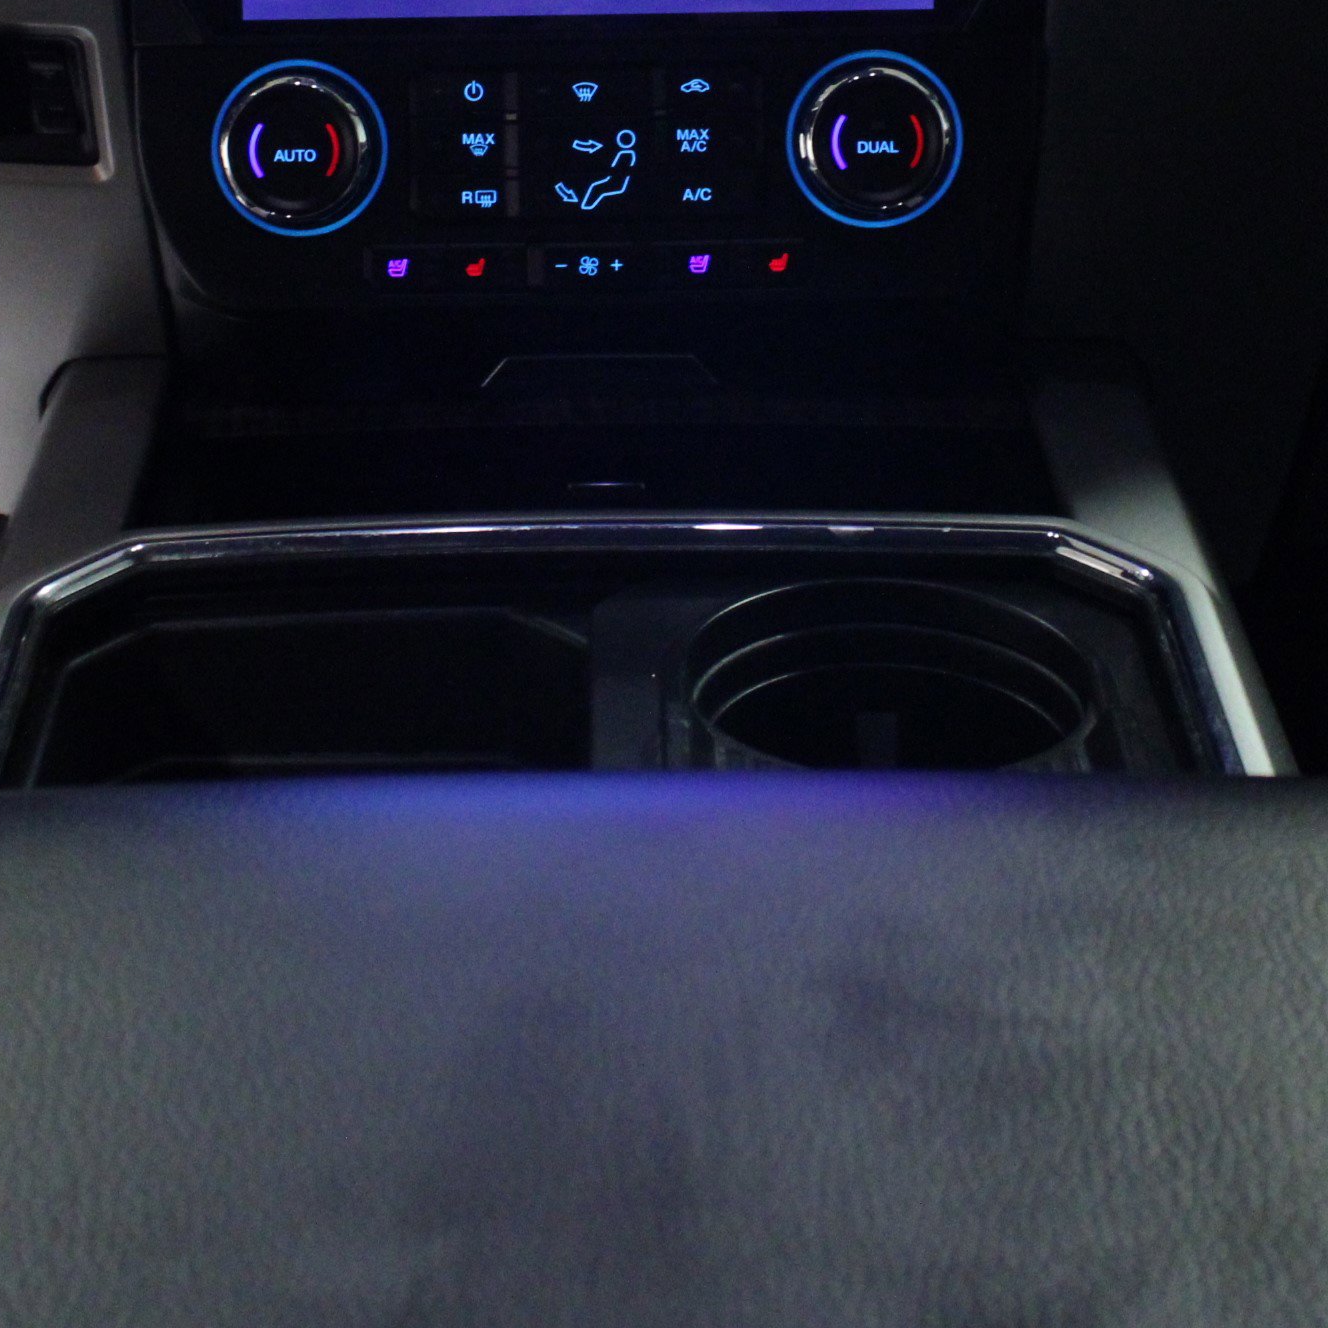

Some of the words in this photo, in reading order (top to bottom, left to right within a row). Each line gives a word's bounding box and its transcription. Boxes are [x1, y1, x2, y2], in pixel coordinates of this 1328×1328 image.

[461, 133, 495, 145] MAX
[676, 128, 709, 141] MAX
[680, 139, 707, 153] A/C
[856, 140, 899, 154] DUAL
[274, 148, 317, 163] AUTO
[461, 191, 473, 204] R
[682, 187, 712, 202] A/C
